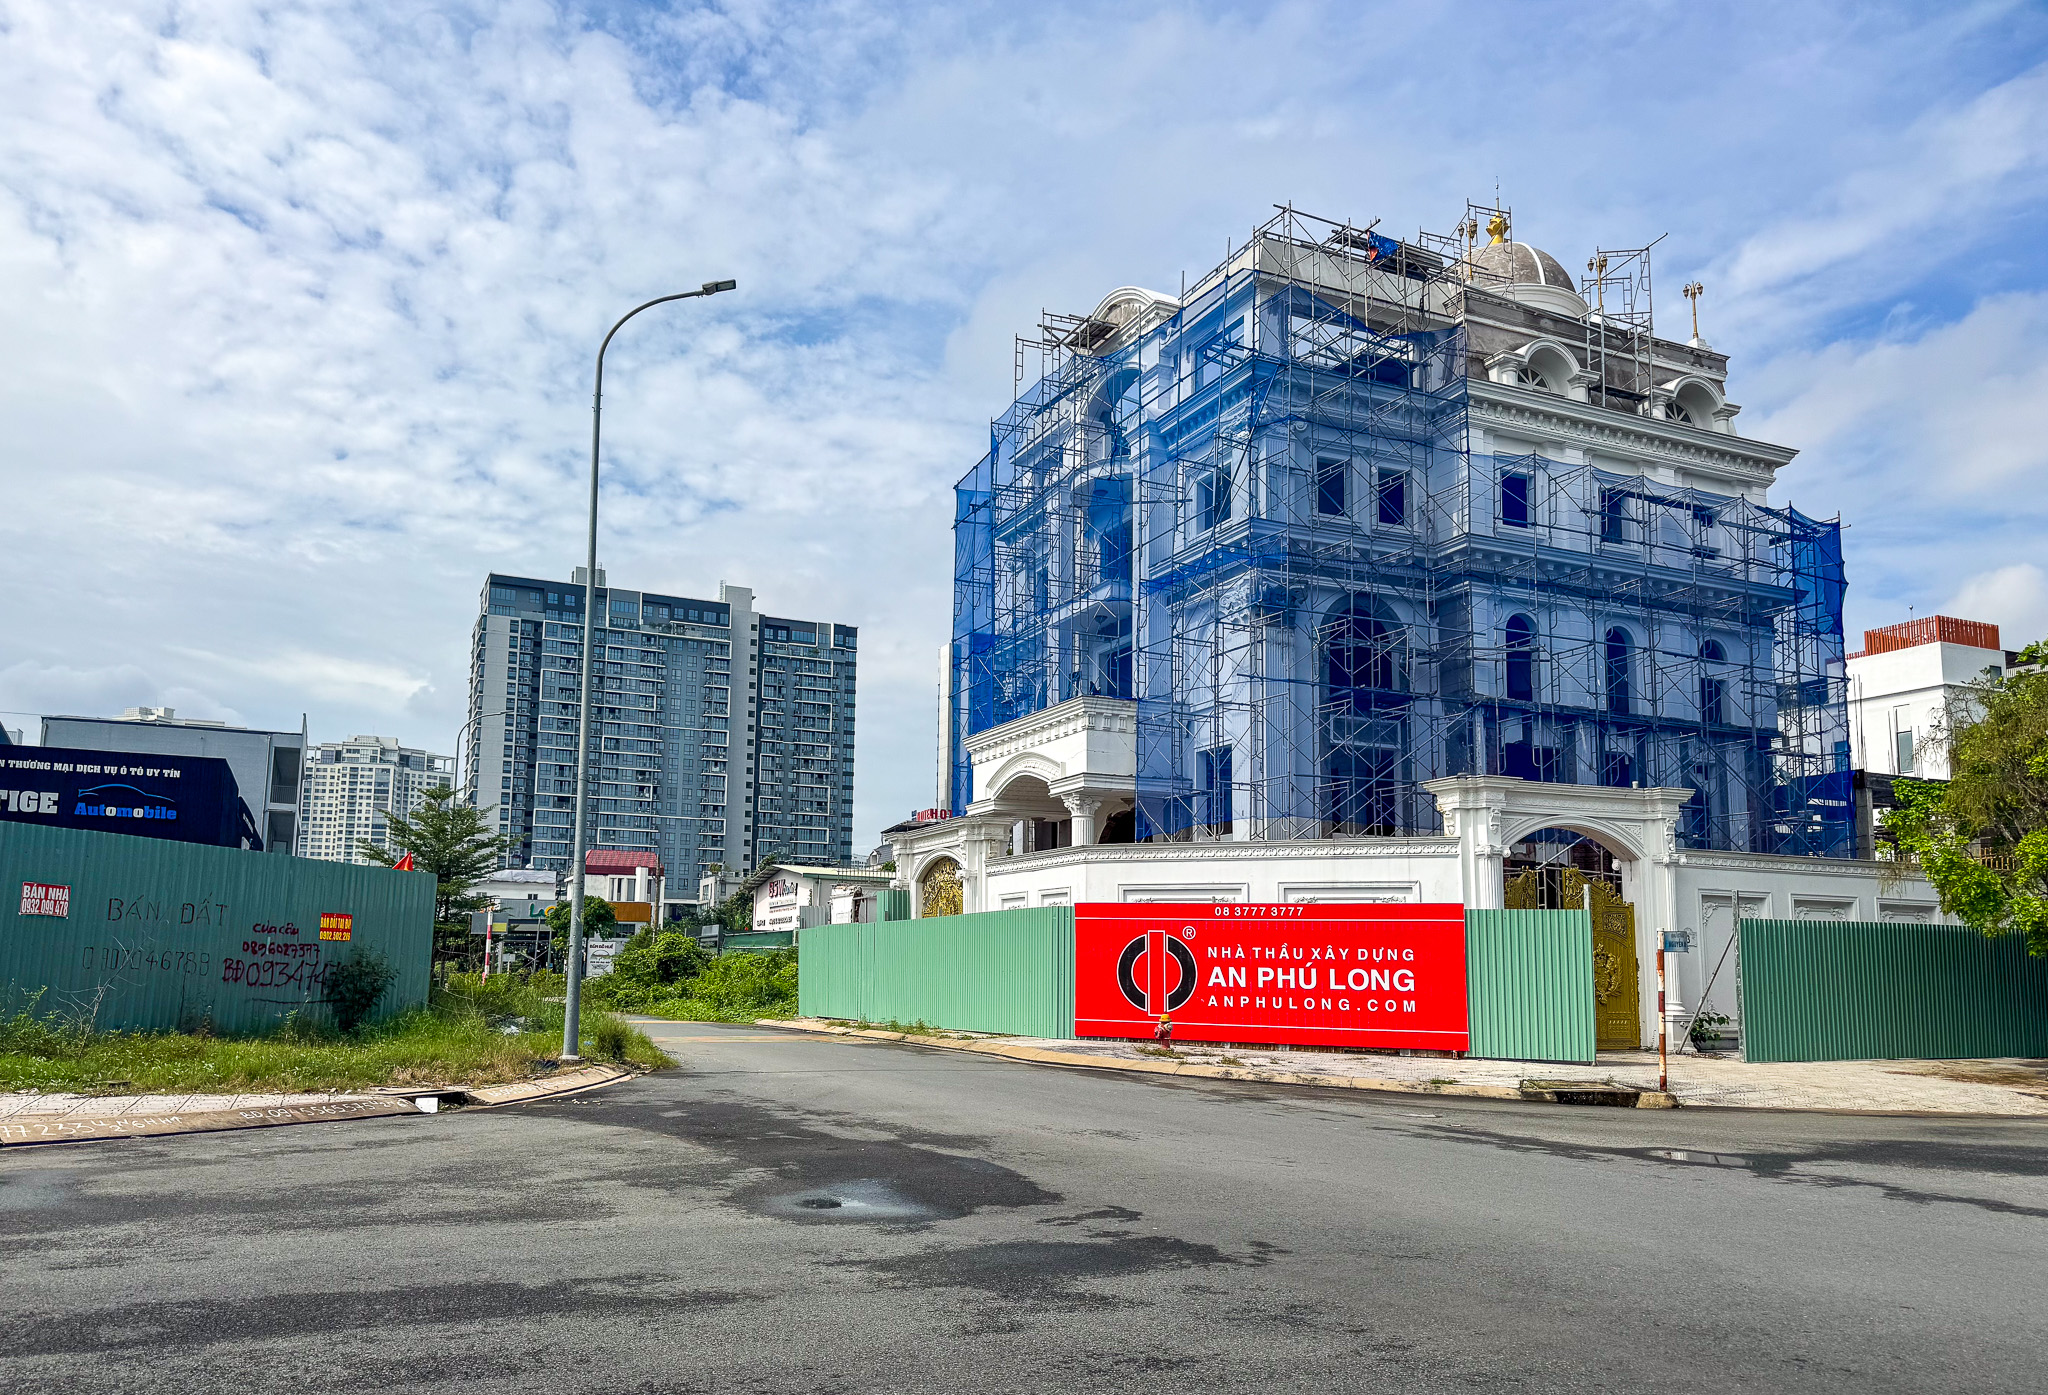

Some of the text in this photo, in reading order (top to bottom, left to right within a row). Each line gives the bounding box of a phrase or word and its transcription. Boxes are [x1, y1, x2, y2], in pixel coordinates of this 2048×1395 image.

[8, 759, 51, 770] THƯƠNG
[53, 762, 74, 773] MẠI
[76, 764, 101, 774] DỊCH
[104, 766, 118, 776] VỤ
[120, 765, 127, 775] Ô
[130, 766, 144, 776] TÔ
[146, 768, 160, 777] UY
[163, 768, 181, 778] TÍN
[74, 802, 177, 820] Automobile
[23, 883, 69, 901] BÁN NHÀ
[21, 898, 69, 916] 0932 099 478
[107, 892, 229, 927] BÁN ĐẤT
[1214, 907, 1304, 917] 08 3777 3777
[1207, 943, 1415, 963] NHÀ THẦU XÂY DỰNG
[1207, 962, 1415, 992] AN PHÚ LONG
[1207, 995, 1416, 1013] ANPHULONG.COM
